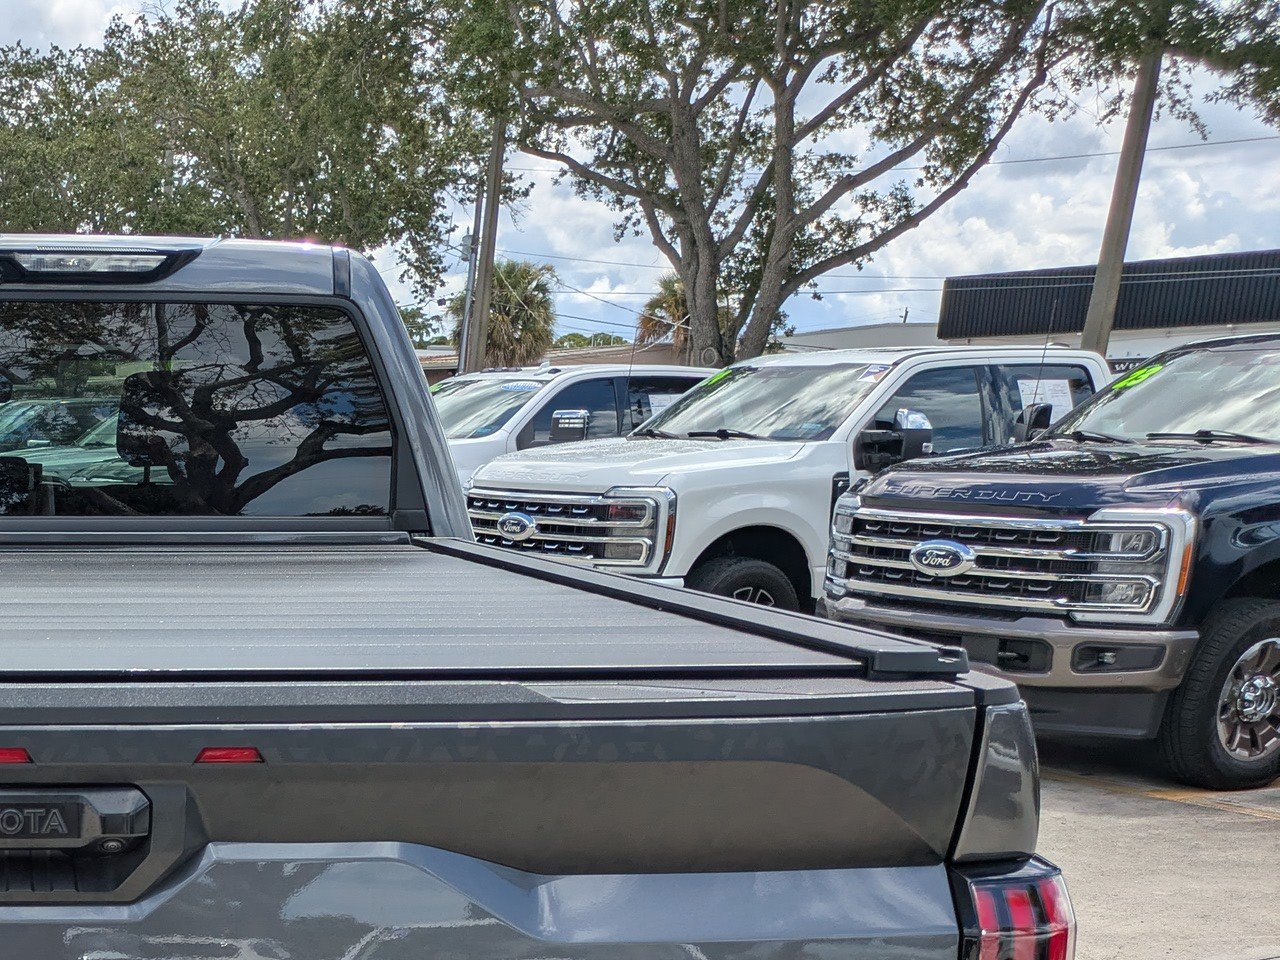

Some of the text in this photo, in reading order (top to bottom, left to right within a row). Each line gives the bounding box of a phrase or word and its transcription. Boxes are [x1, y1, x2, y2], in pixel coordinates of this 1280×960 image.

[882, 483, 1062, 502] SUPER DUTY
[921, 549, 954, 568] Ford
